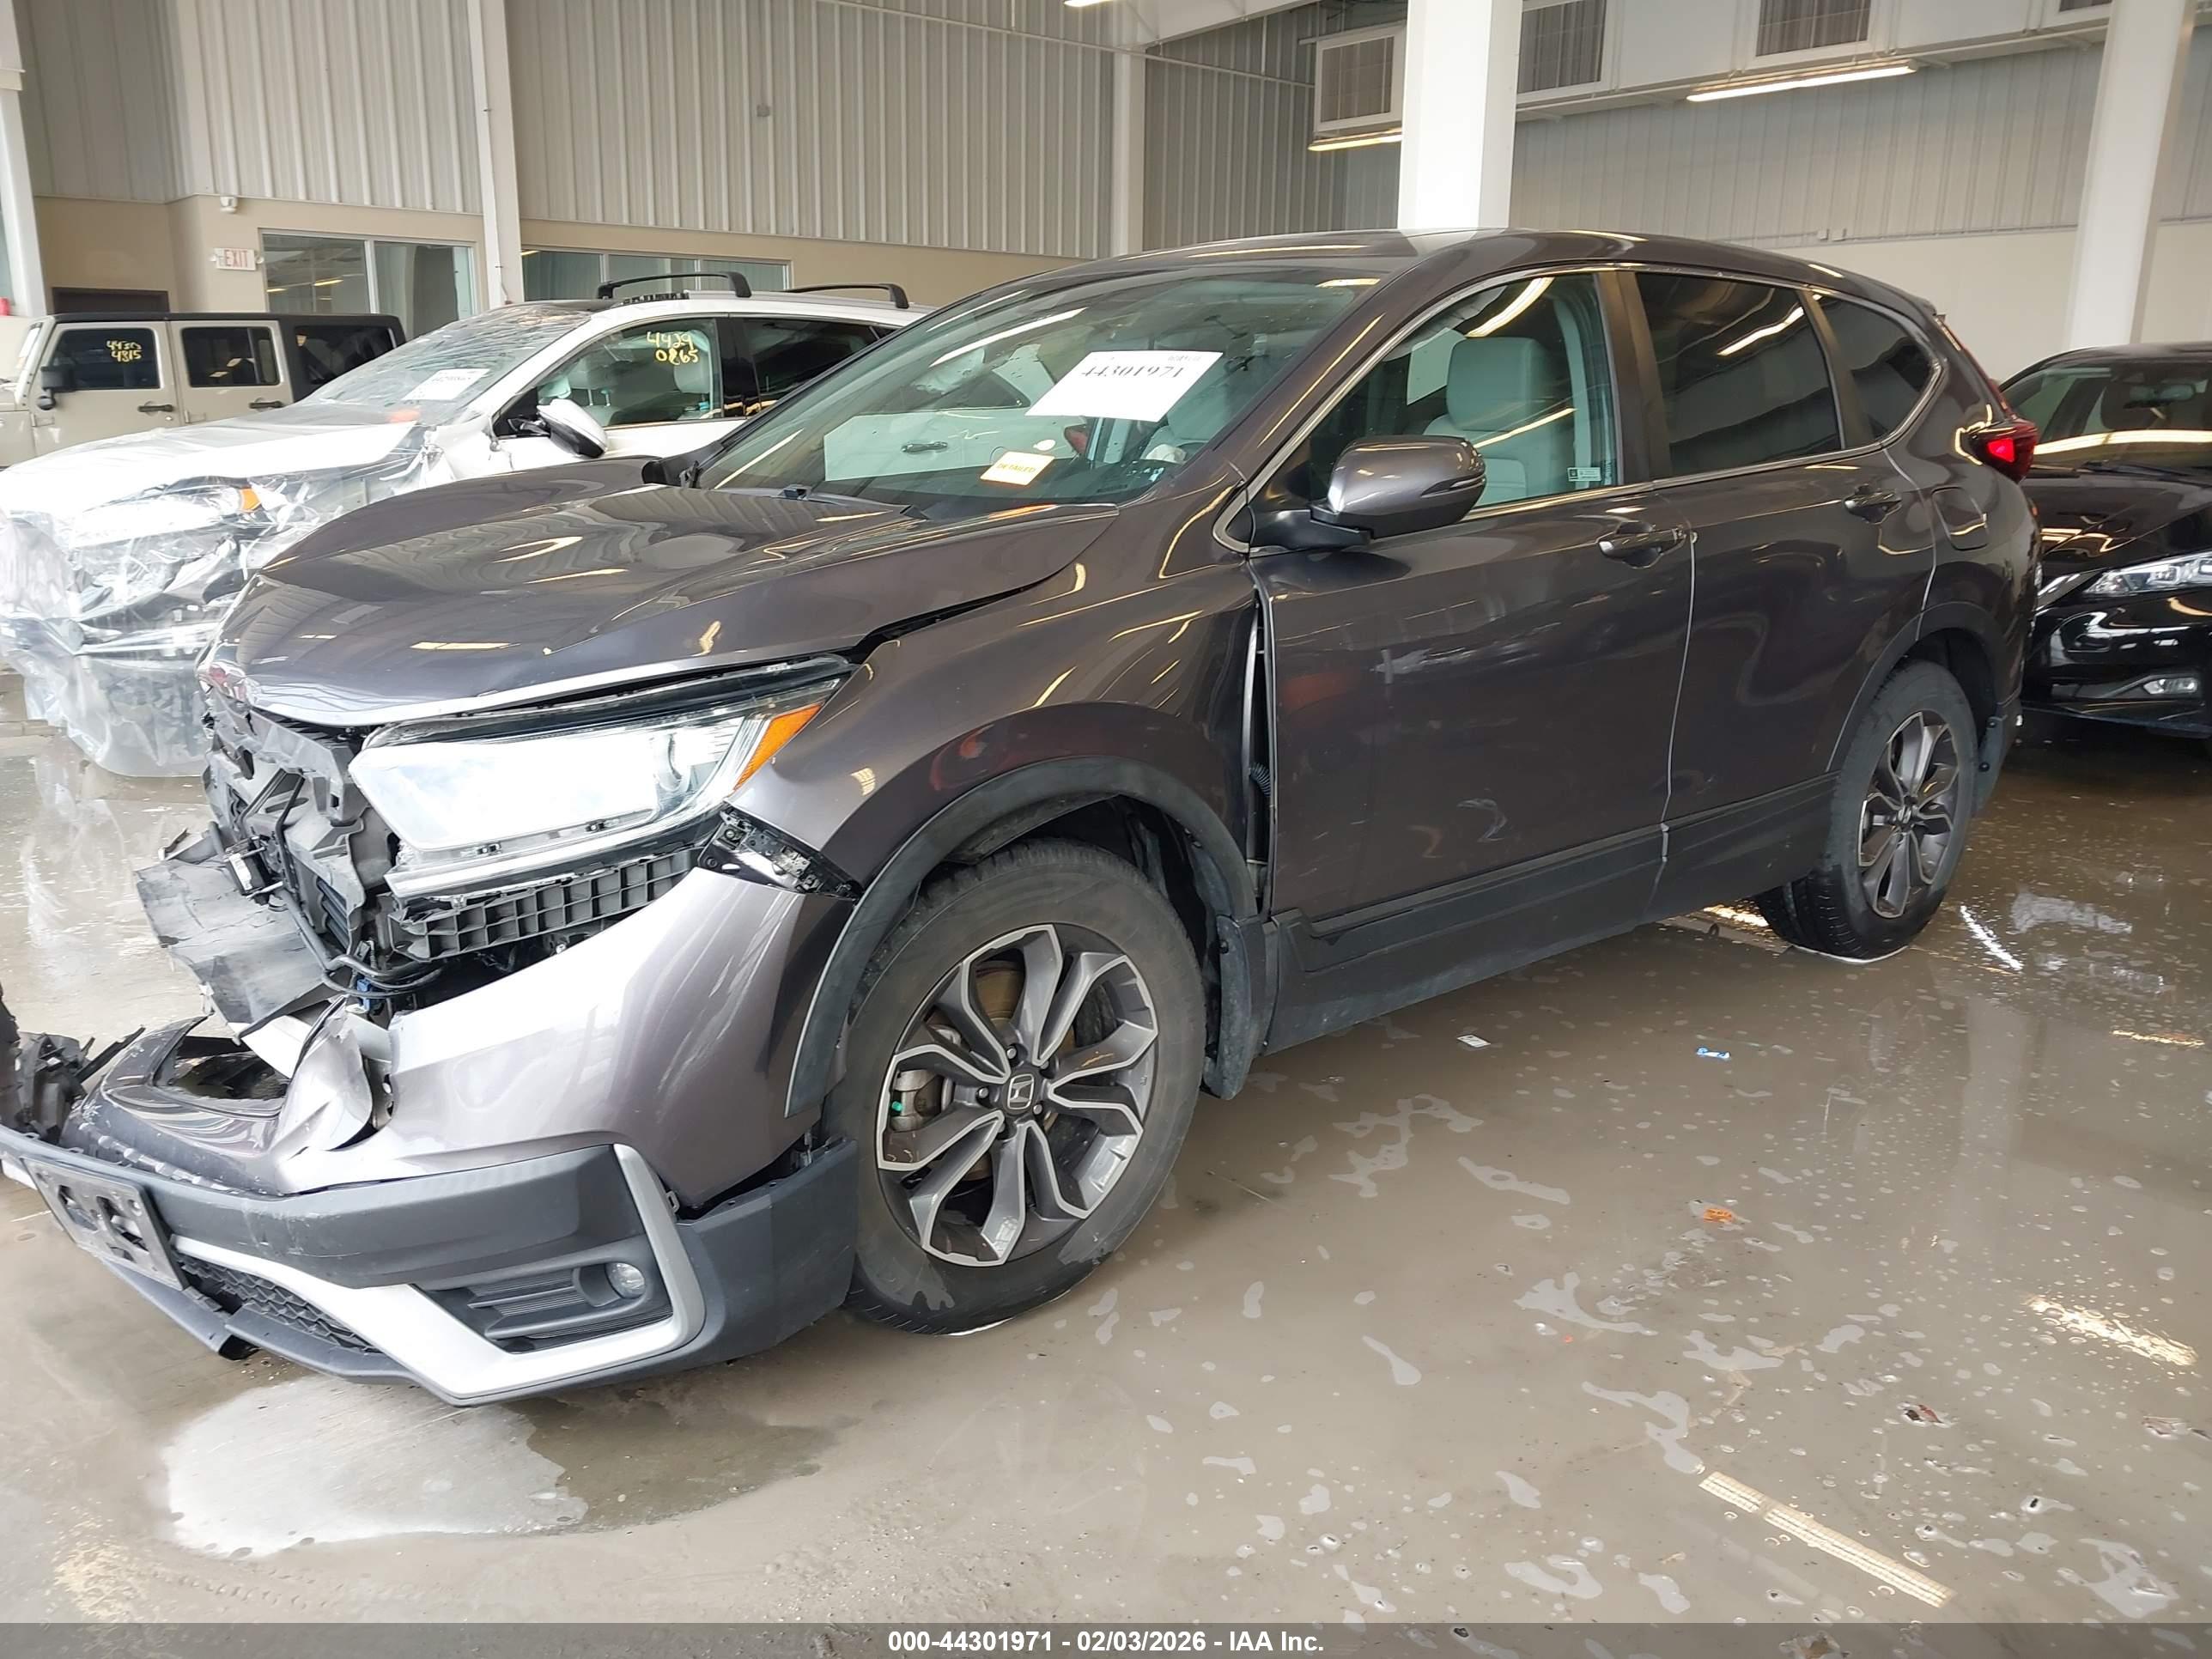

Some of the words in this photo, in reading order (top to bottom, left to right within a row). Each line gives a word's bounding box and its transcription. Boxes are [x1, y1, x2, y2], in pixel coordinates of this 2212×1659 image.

[224, 249, 248, 267] EXIT
[647, 331, 694, 350] 4429
[111, 349, 143, 362] 4815
[655, 348, 699, 366] 0865
[1081, 366, 1185, 378] 44301971
